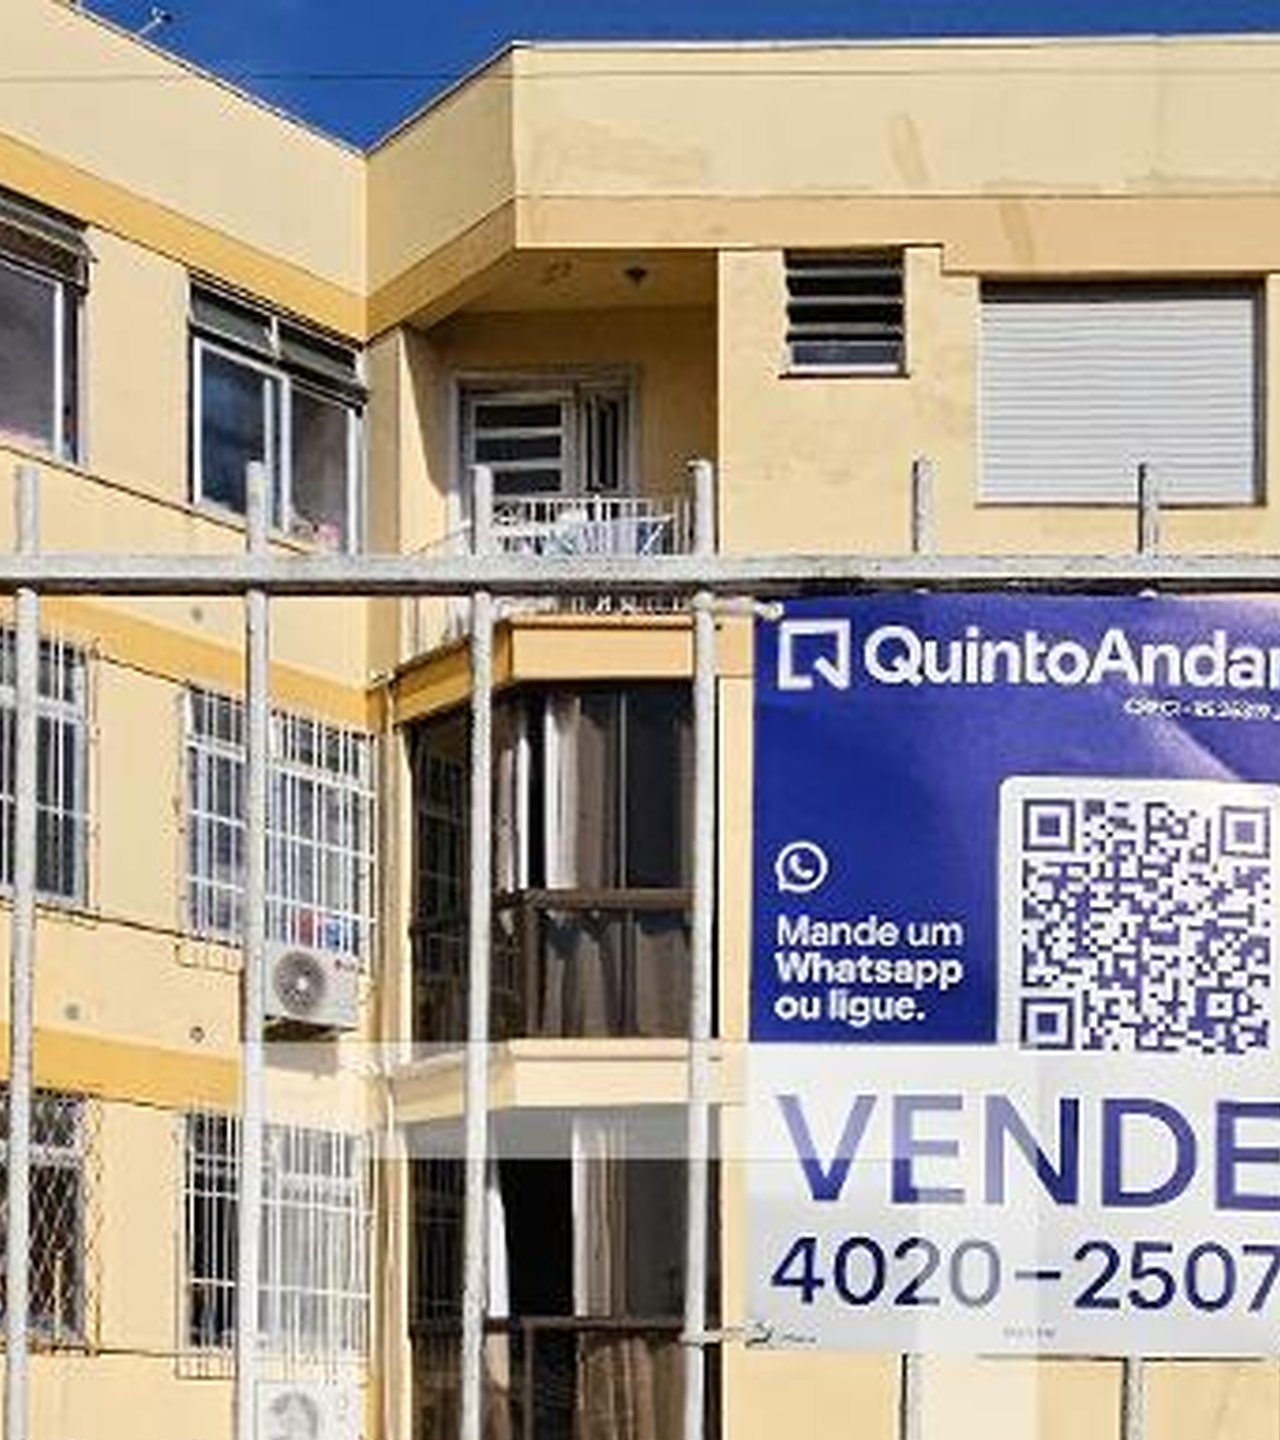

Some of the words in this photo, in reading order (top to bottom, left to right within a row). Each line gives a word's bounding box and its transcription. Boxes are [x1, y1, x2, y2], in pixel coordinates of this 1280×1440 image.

[776, 915, 901, 947] Mande
[908, 922, 963, 947] um
[775, 952, 963, 990] Whatsapp
[775, 998, 821, 1021] ou
[829, 989, 926, 1028] ligue.
